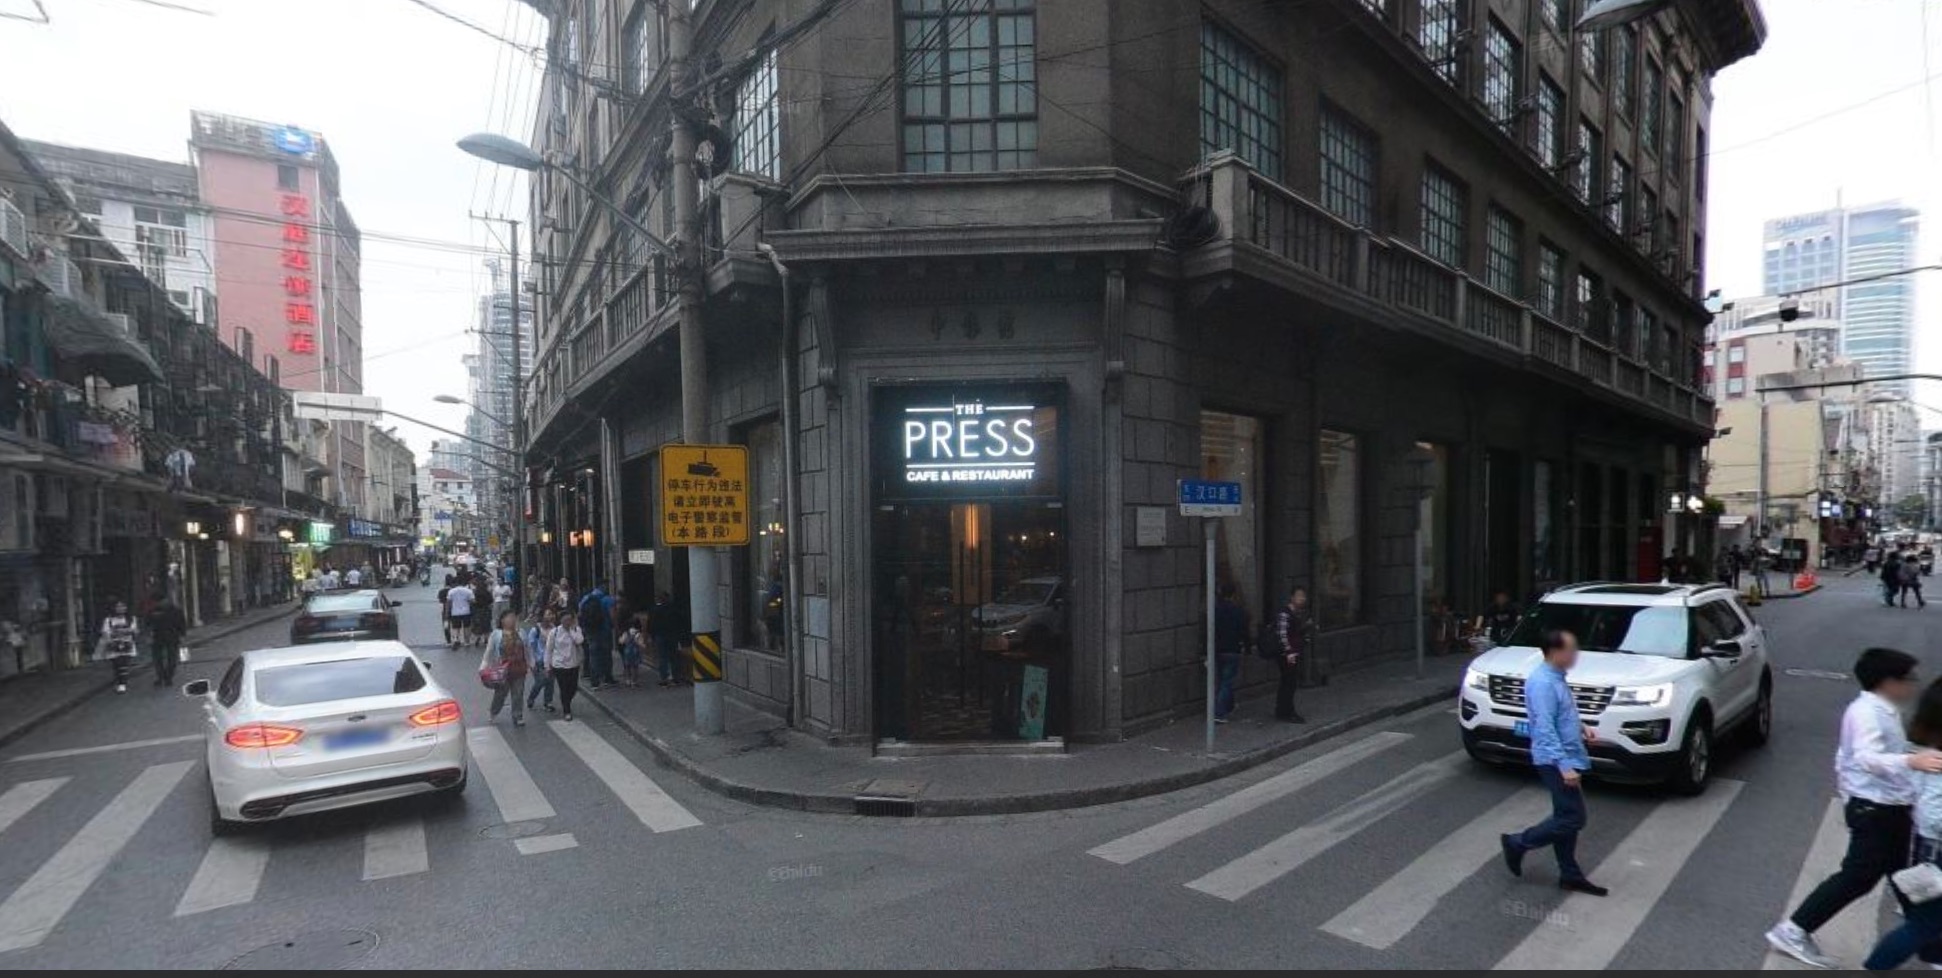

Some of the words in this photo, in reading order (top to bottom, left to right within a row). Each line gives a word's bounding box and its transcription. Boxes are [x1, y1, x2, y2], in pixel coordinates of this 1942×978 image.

[955, 403, 984, 415] THE
[905, 418, 1035, 459] PRESS
[906, 470, 939, 481] CAFE
[941, 470, 951, 481] &
[952, 468, 1034, 480] RESTAURANT
[667, 479, 742, 492] 停车行为违法
[1195, 485, 1228, 502] 汉口路
